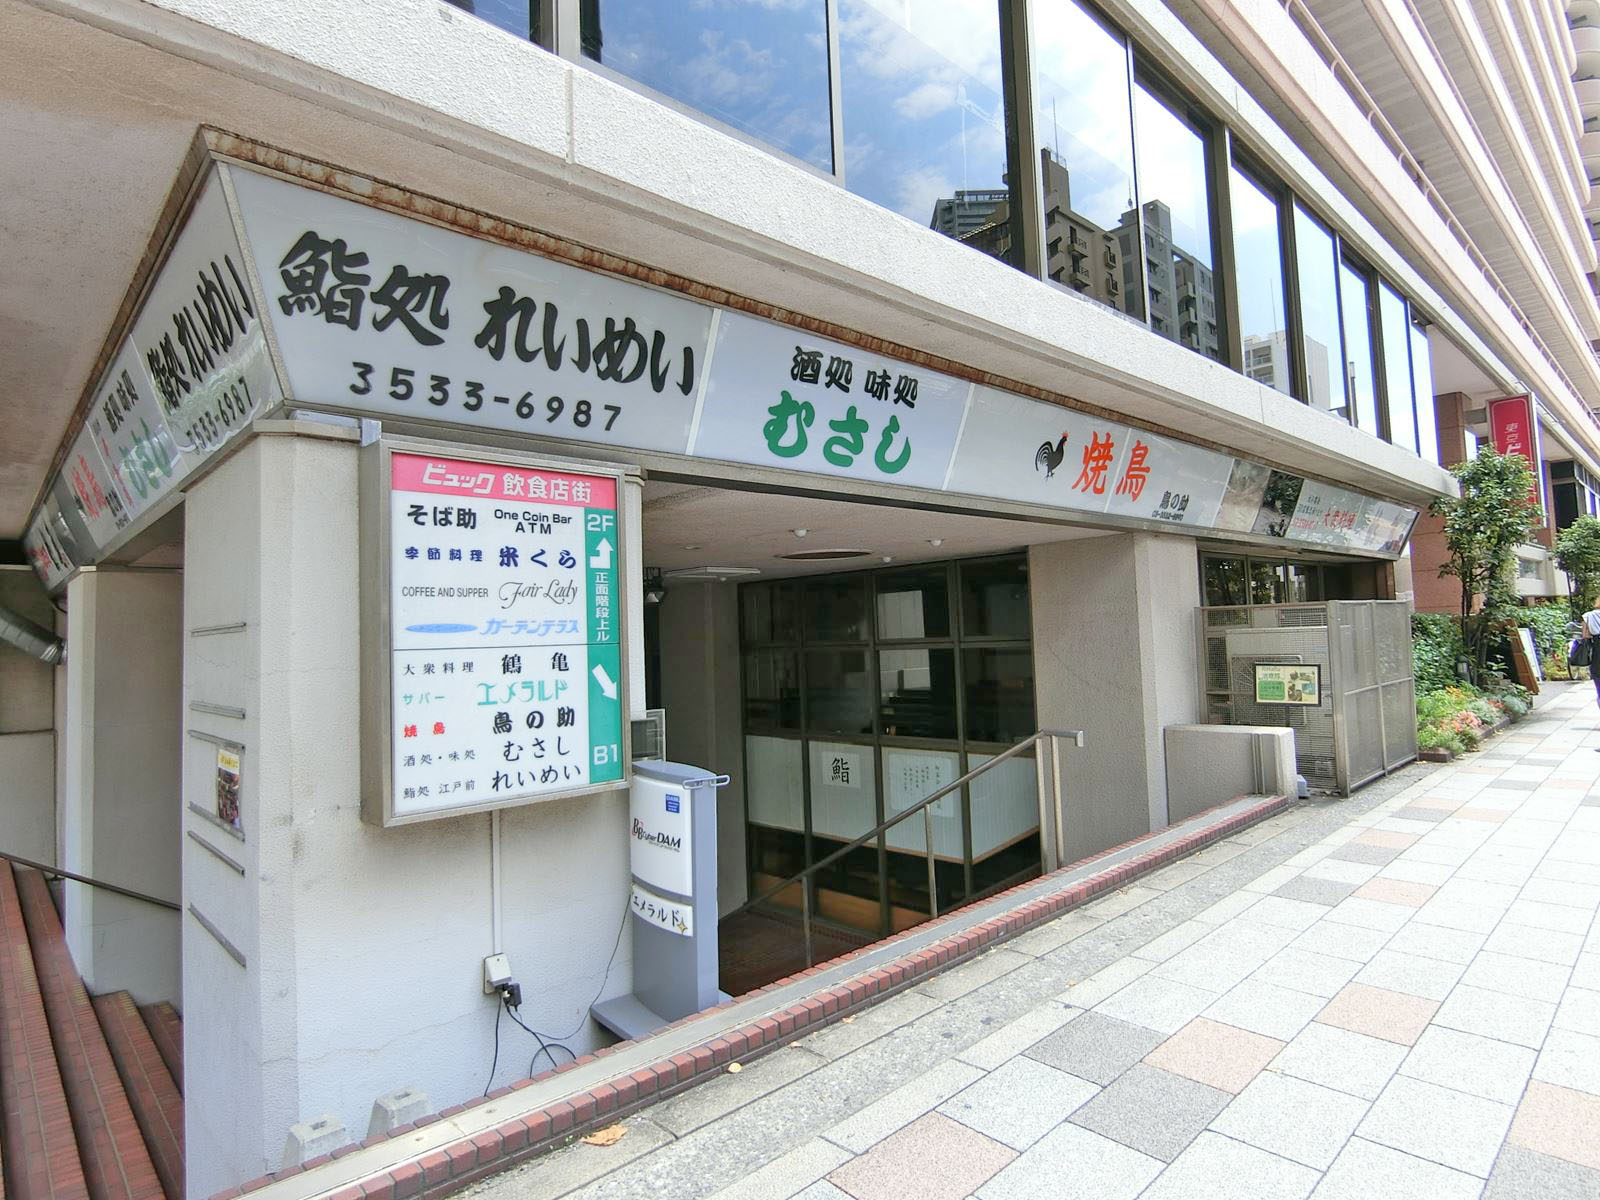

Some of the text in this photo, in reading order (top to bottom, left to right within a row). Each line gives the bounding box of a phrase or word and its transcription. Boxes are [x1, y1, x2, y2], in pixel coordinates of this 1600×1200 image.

[172, 254, 255, 383] れいめい
[278, 231, 694, 396] 鮨処 れいめい
[790, 345, 919, 409] 酒処 味処
[348, 361, 622, 431] 3533-6987
[763, 390, 912, 474] むさし
[1072, 430, 1151, 502] 焼鳥
[421, 462, 592, 503] ビュック 飲食店街
[407, 503, 477, 530] そば助
[494, 509, 572, 525] One Coin Bar
[586, 513, 614, 532] 2F
[404, 546, 483, 562] 季節料理
[402, 586, 489, 598] COFFEE AND SUPPER
[498, 579, 578, 609] Fair Lady
[595, 572, 610, 642] 正面階段上ル
[402, 660, 474, 676] 大衆料理
[477, 680, 568, 706] エメラルド
[404, 721, 446, 738] 焼鳥
[493, 706, 575, 735] 鳥の助
[504, 736, 571, 762] むさし
[593, 744, 618, 766] B1
[491, 765, 581, 793] れいめい
[831, 757, 850, 785] 鮨
[403, 786, 430, 799] 鮨処
[657, 832, 681, 848] DAM
[633, 895, 679, 927] エメラルド
